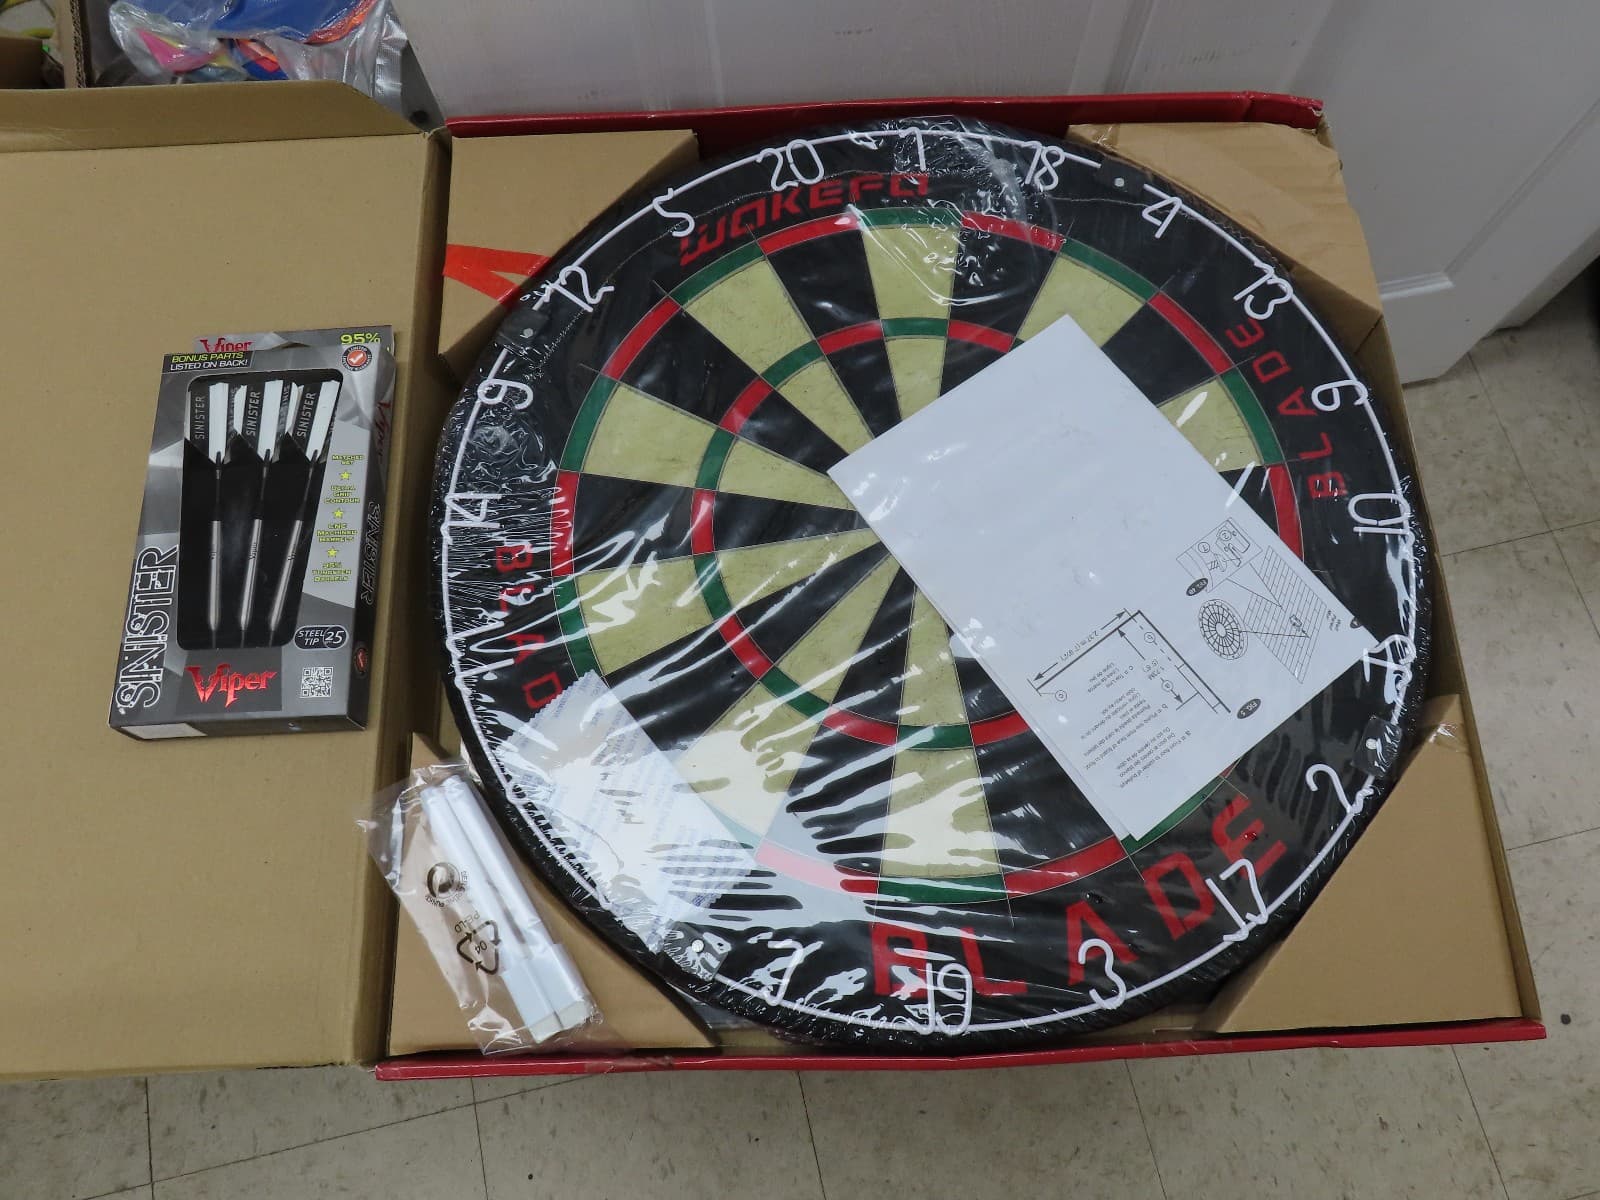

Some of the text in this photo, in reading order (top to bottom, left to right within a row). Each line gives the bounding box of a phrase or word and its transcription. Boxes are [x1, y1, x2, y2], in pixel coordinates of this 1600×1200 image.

[756, 139, 823, 191] 20
[1021, 140, 1065, 190] 18
[653, 188, 695, 237] 5
[1141, 197, 1183, 238] 4
[549, 266, 614, 312] 12
[1233, 262, 1294, 320] 13
[172, 352, 244, 363] BONUS PARTS
[341, 333, 381, 344] 95%
[170, 359, 248, 371] LISTED ON BACK!
[195, 396, 206, 440] SINISTER
[246, 391, 261, 436] SINISTER
[297, 392, 317, 437] SINISTER
[1225, 317, 1347, 498] BLADE
[1311, 379, 1369, 412] 6
[1348, 493, 1414, 540] 10
[116, 544, 179, 708] SINISTER
[298, 629, 325, 638] STEEL
[325, 630, 344, 644] 25
[304, 638, 320, 646] TIP
[495, 543, 563, 708] BLAD
[184, 663, 278, 708] Viper
[1305, 763, 1364, 816] 2
[868, 794, 1287, 997] BLADE
[1205, 858, 1268, 941] 17
[454, 909, 481, 934] PE-LD
[474, 939, 488, 955] 04
[768, 939, 803, 1006] 7
[1078, 938, 1126, 1009] 3
[920, 962, 973, 1036] 19
